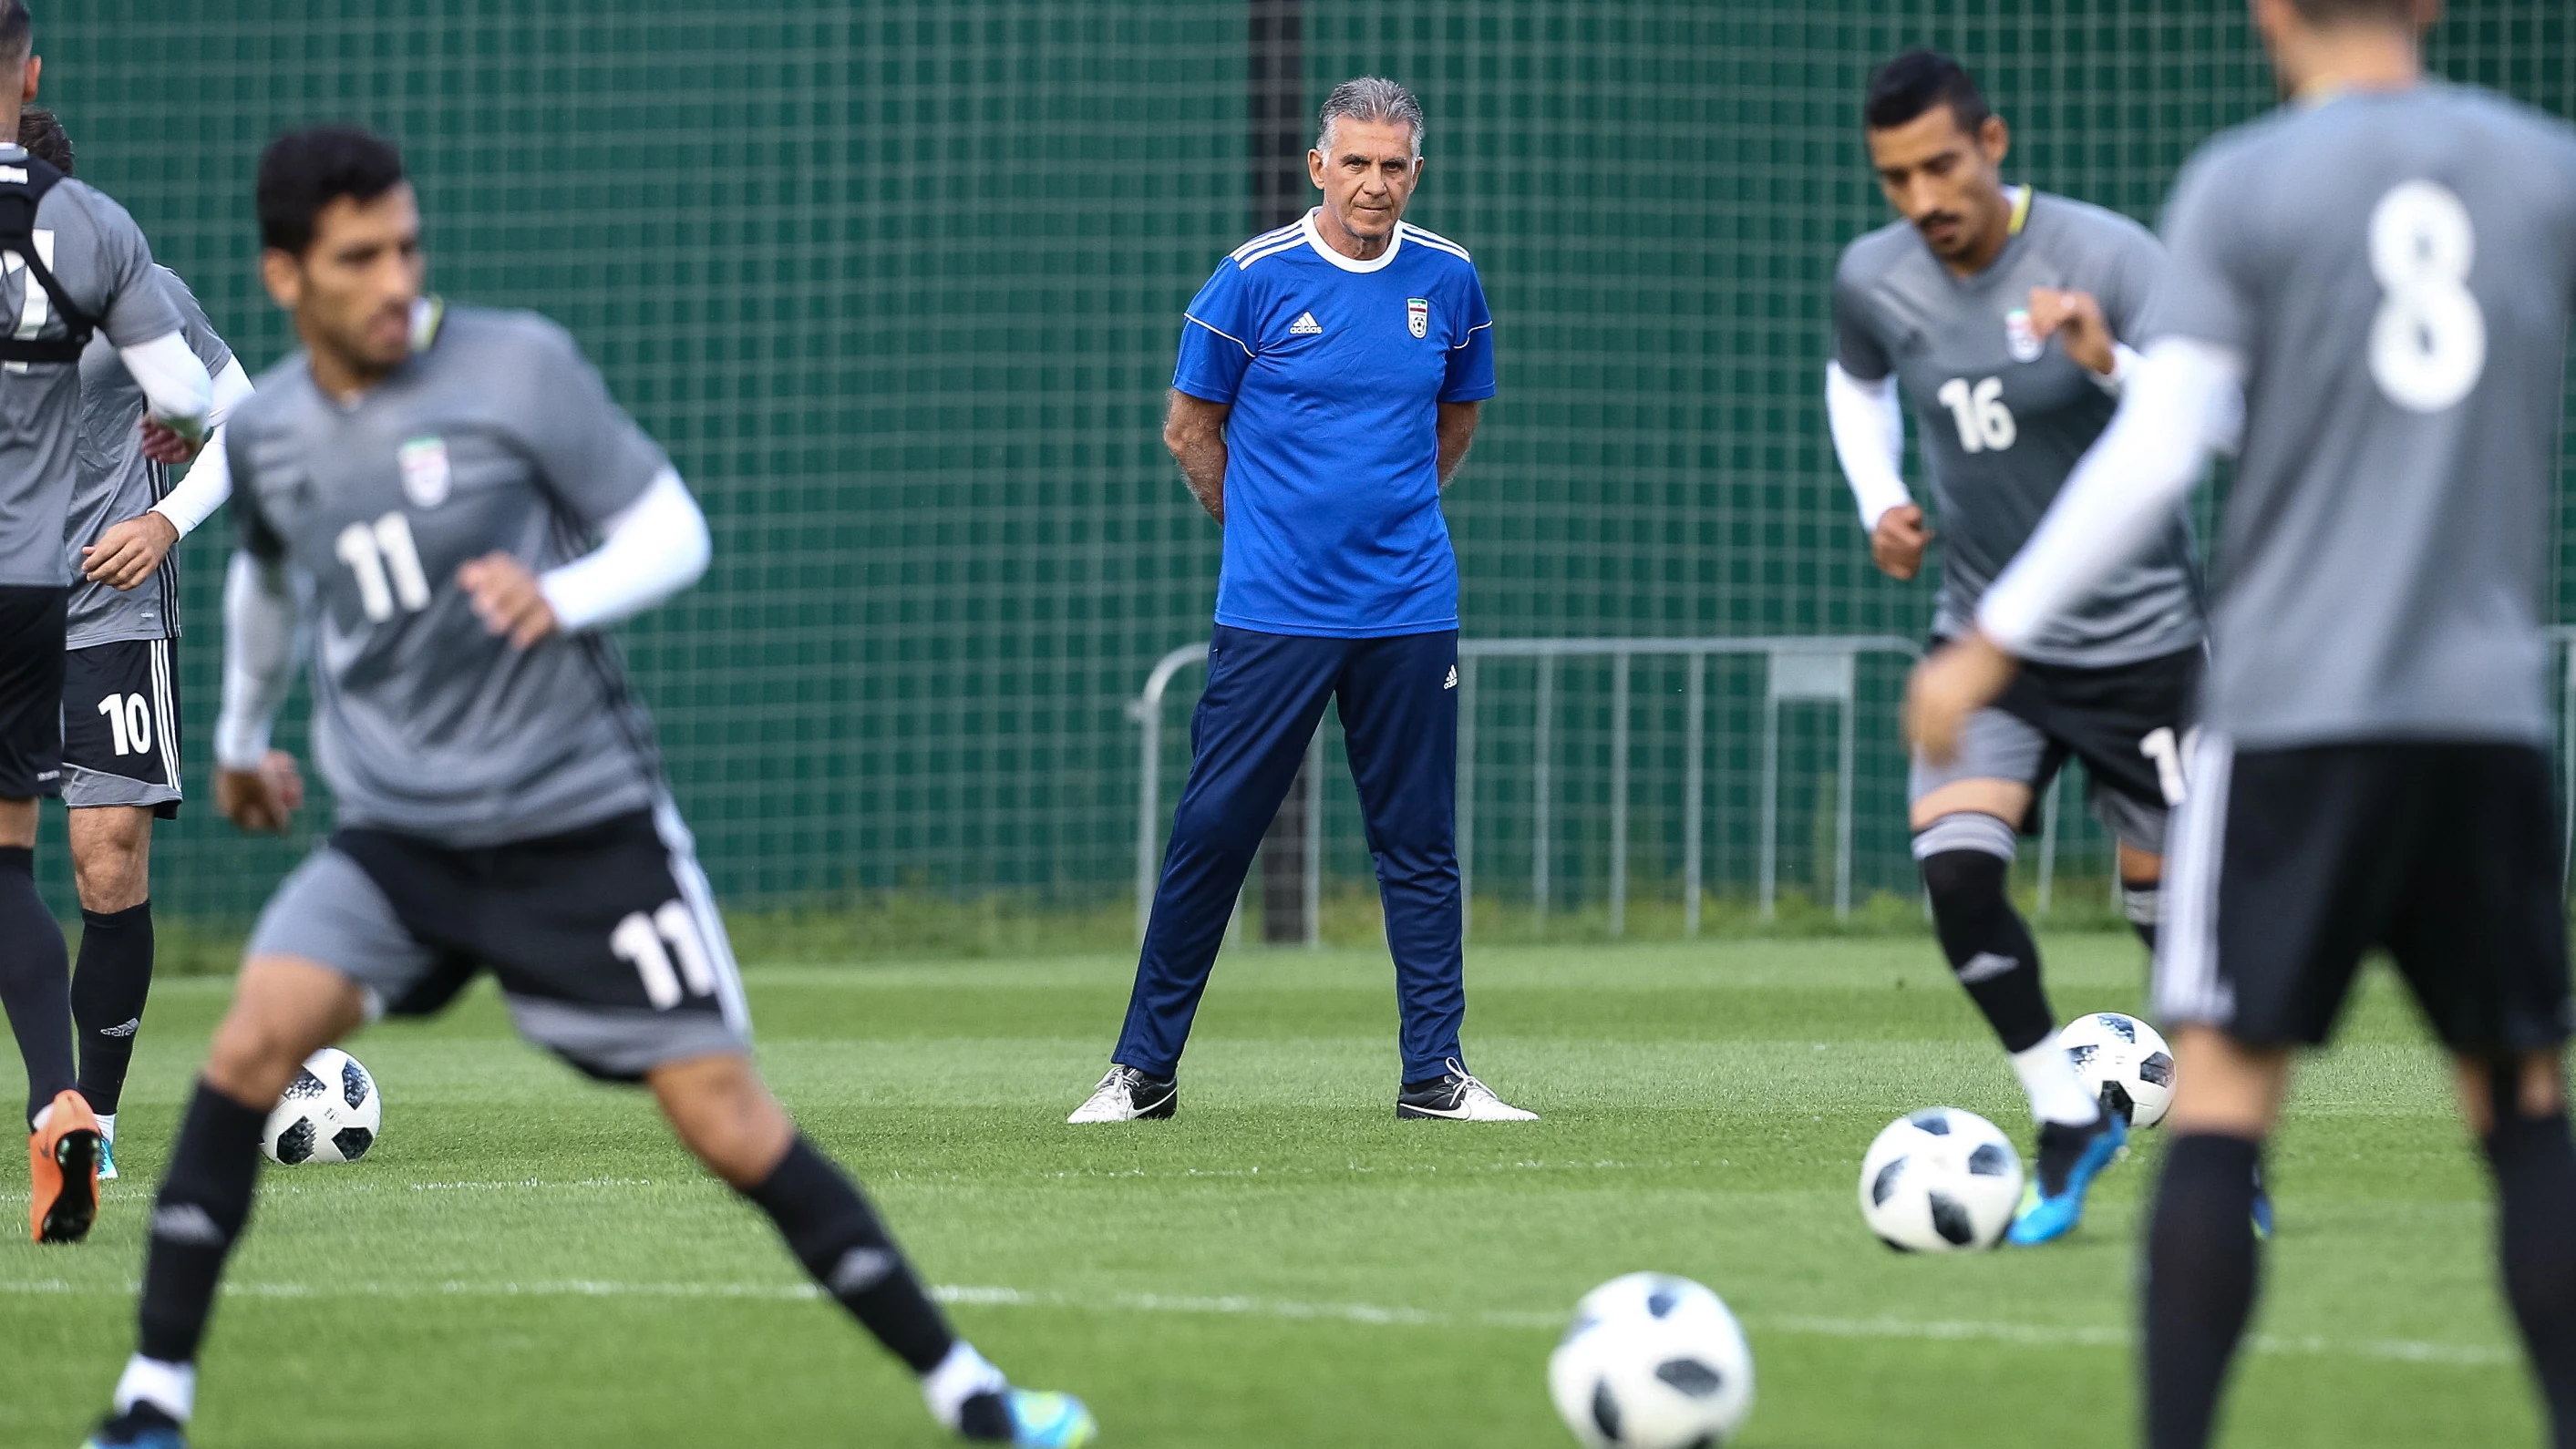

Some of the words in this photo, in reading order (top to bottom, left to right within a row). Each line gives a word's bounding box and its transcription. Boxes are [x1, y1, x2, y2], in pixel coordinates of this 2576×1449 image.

[1289, 325, 1323, 334] adidas
[2367, 180, 2488, 413] 8
[1936, 375, 2017, 454] 16
[335, 510, 431, 623] 11
[98, 693, 151, 755] 10
[608, 898, 716, 1012] 11
